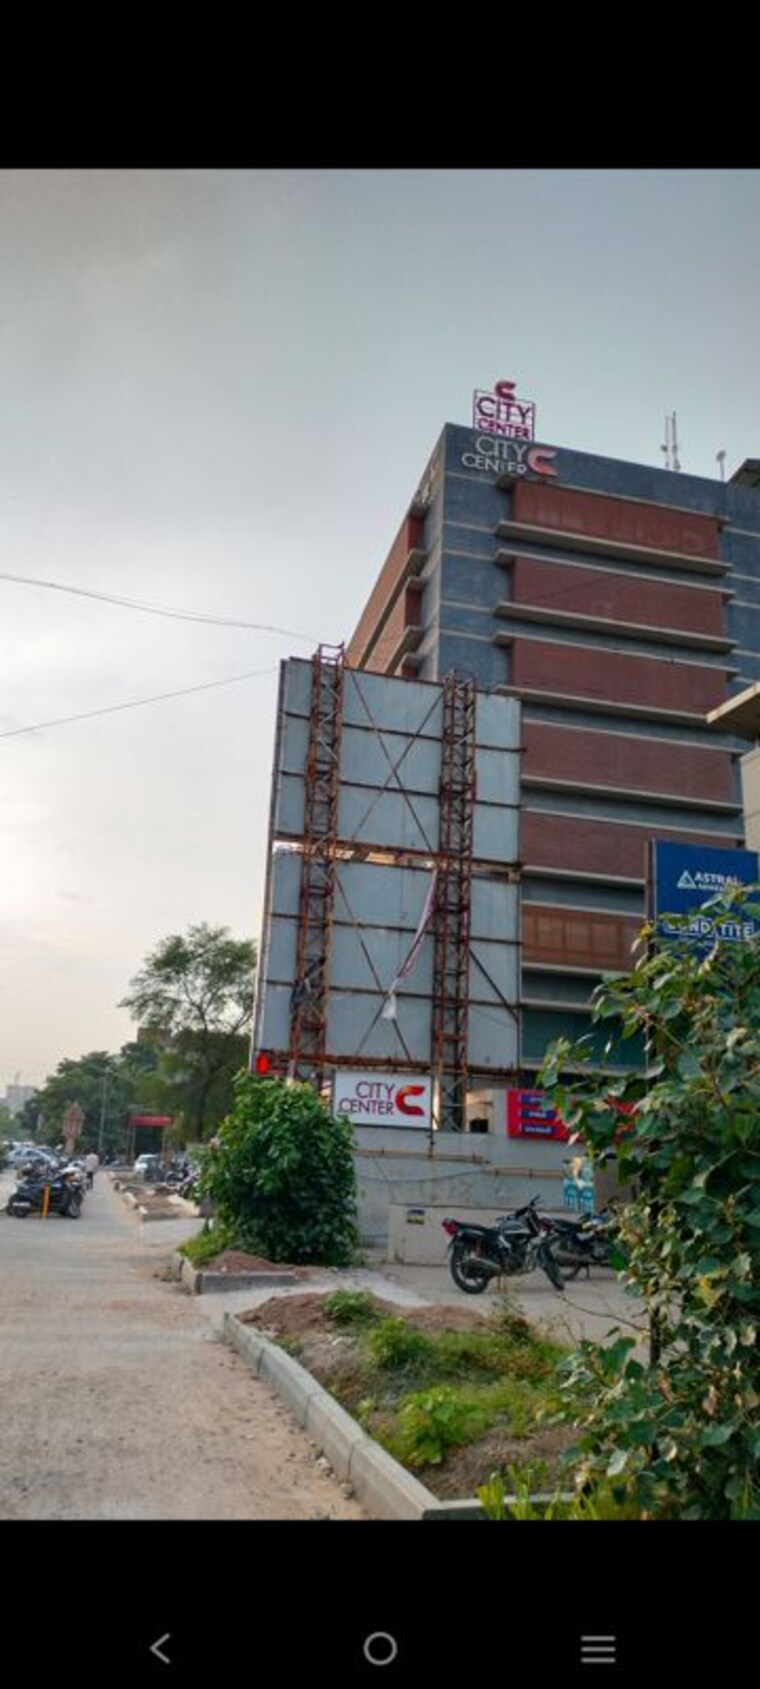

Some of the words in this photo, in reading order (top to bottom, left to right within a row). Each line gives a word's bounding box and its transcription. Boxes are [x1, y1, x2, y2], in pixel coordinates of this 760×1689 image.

[476, 396, 531, 425] CITY
[477, 417, 530, 440] CENTER
[474, 436, 527, 463] CITY
[461, 452, 527, 475] CENTER
[355, 1080, 396, 1101] CITY
[338, 1097, 394, 1116] CENTER
